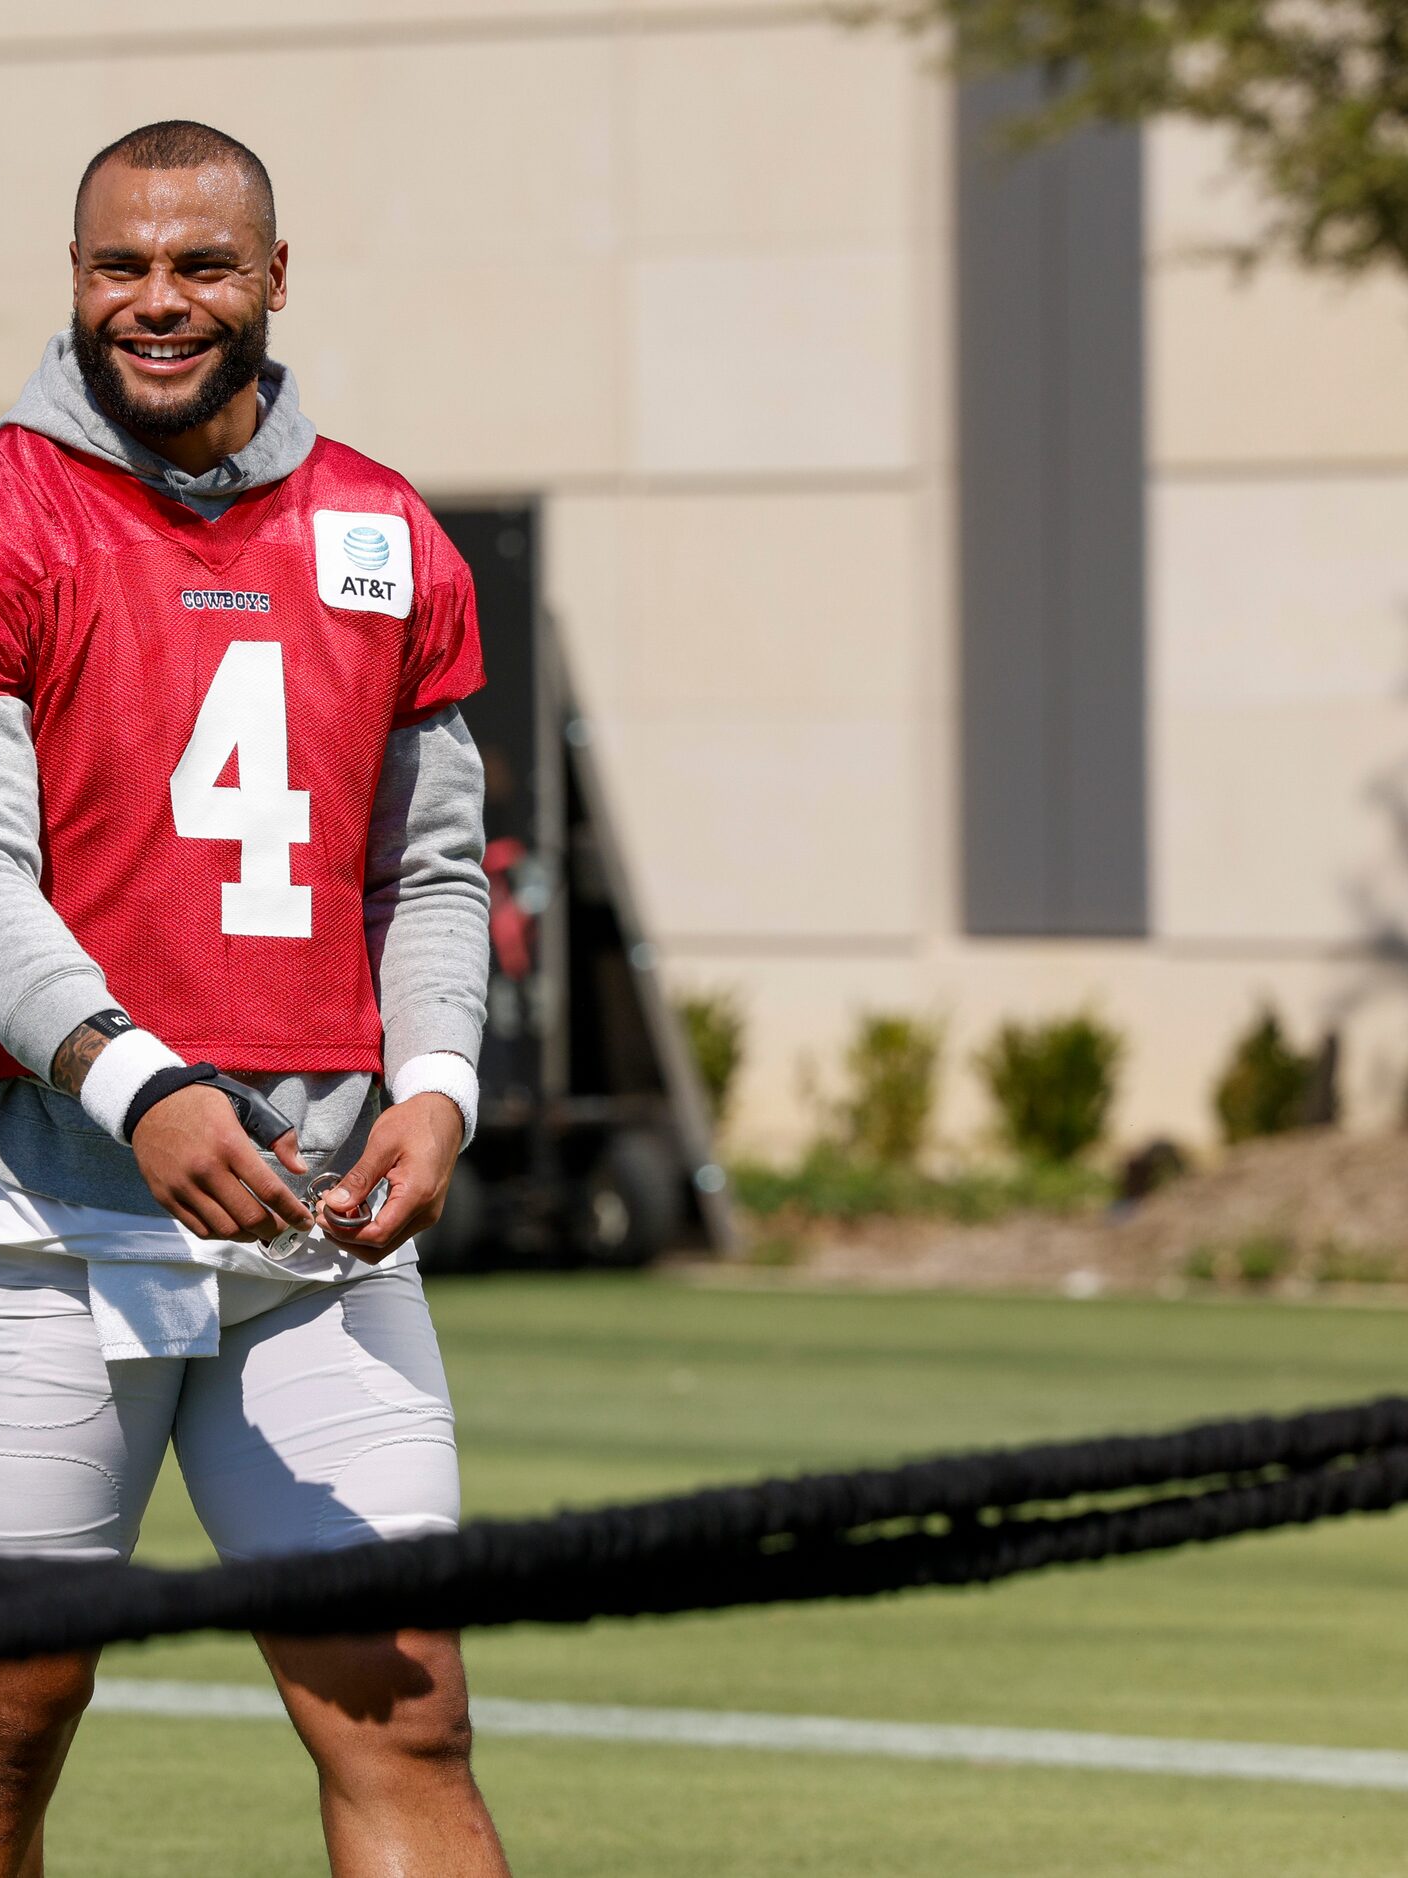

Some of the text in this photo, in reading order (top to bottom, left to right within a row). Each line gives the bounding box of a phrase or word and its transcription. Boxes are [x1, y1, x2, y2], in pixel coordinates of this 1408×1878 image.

[340, 576, 396, 601] AT&T
[182, 590, 270, 613] COWBOYS
[169, 640, 313, 939] 4
